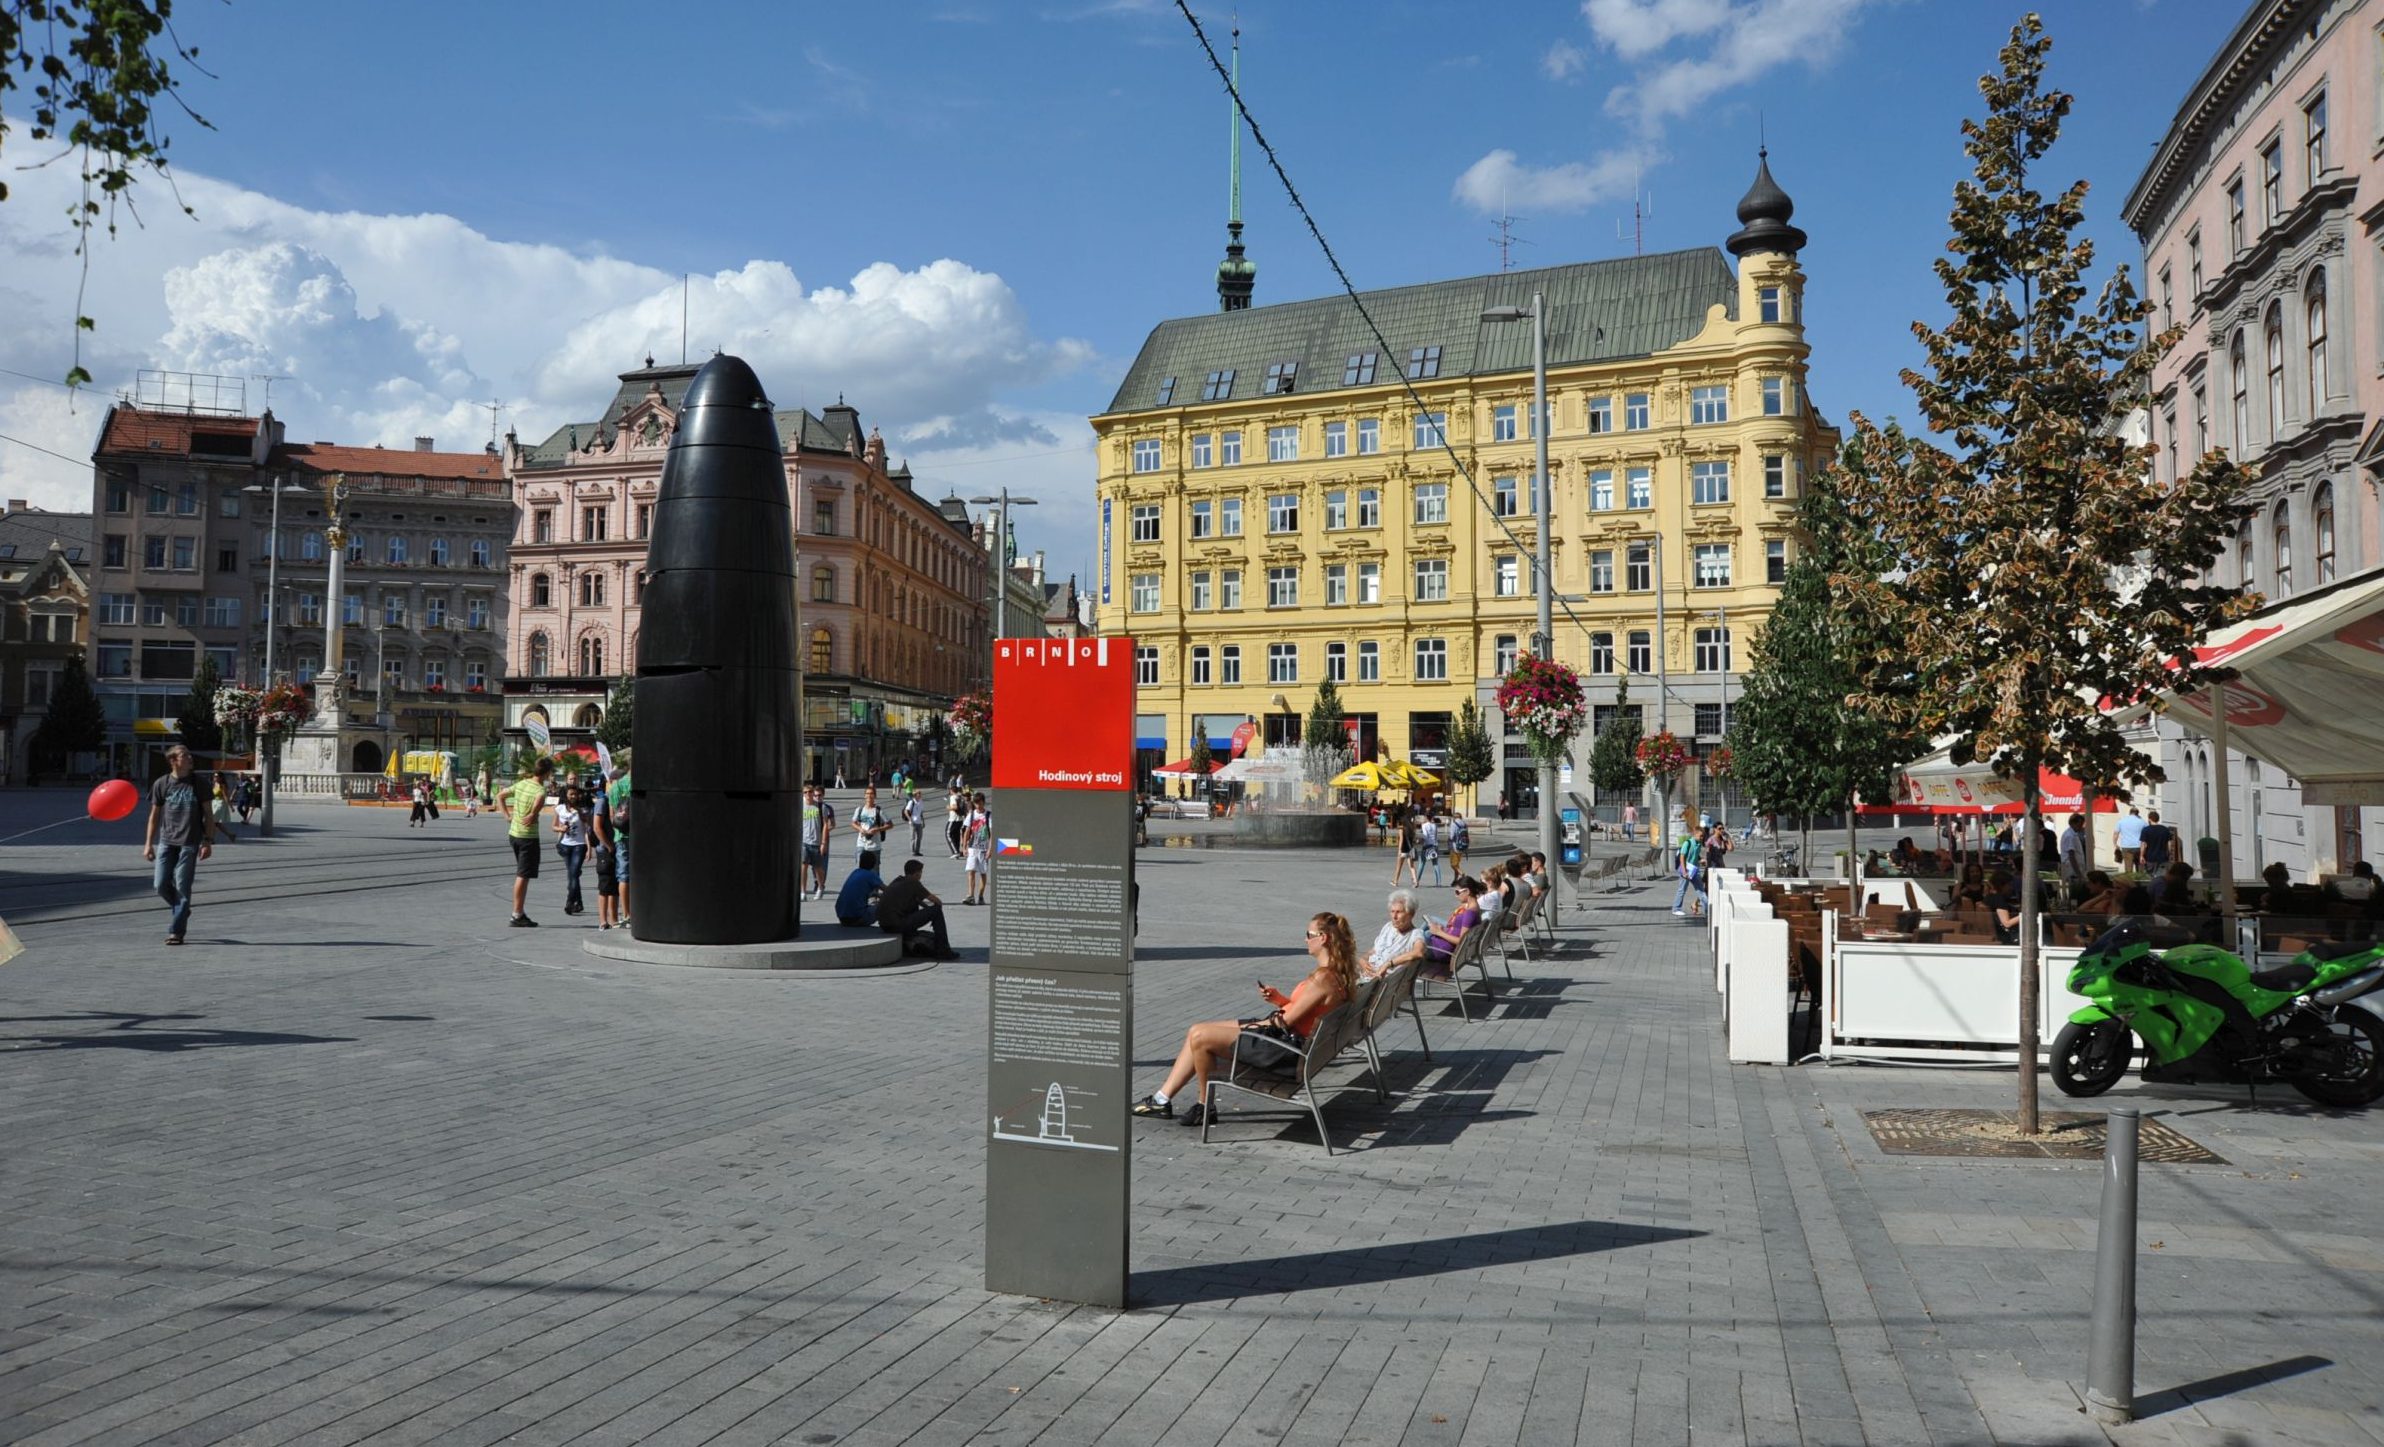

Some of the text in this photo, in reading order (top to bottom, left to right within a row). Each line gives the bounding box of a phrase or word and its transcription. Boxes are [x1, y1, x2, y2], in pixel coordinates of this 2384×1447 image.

[1001, 647, 1092, 657] BRNO
[1038, 770, 1122, 785] Hodinový stroj
